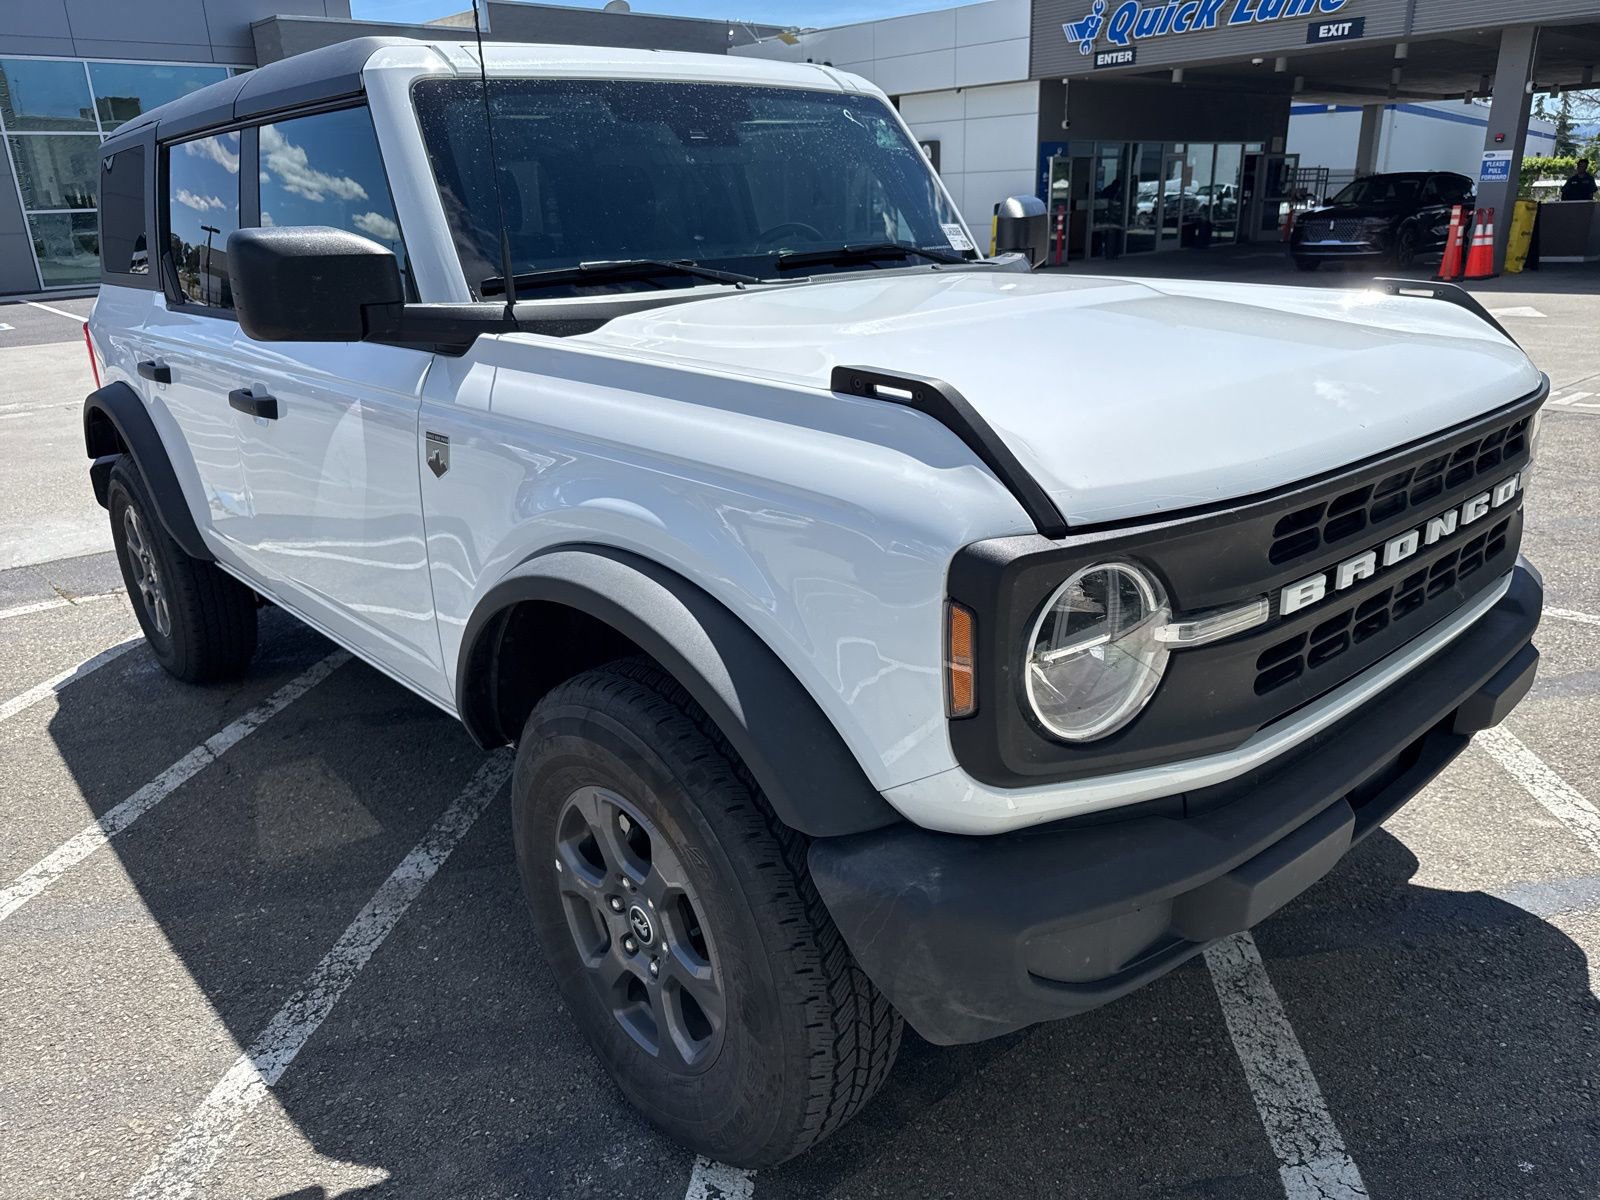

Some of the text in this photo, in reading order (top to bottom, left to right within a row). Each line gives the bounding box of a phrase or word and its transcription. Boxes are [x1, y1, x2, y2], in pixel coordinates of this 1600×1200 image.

[1107, 0, 1226, 46] Quick
[1319, 23, 1352, 38] EXIT
[1097, 51, 1133, 65] ENTER
[1279, 477, 1517, 616] BRONCO
